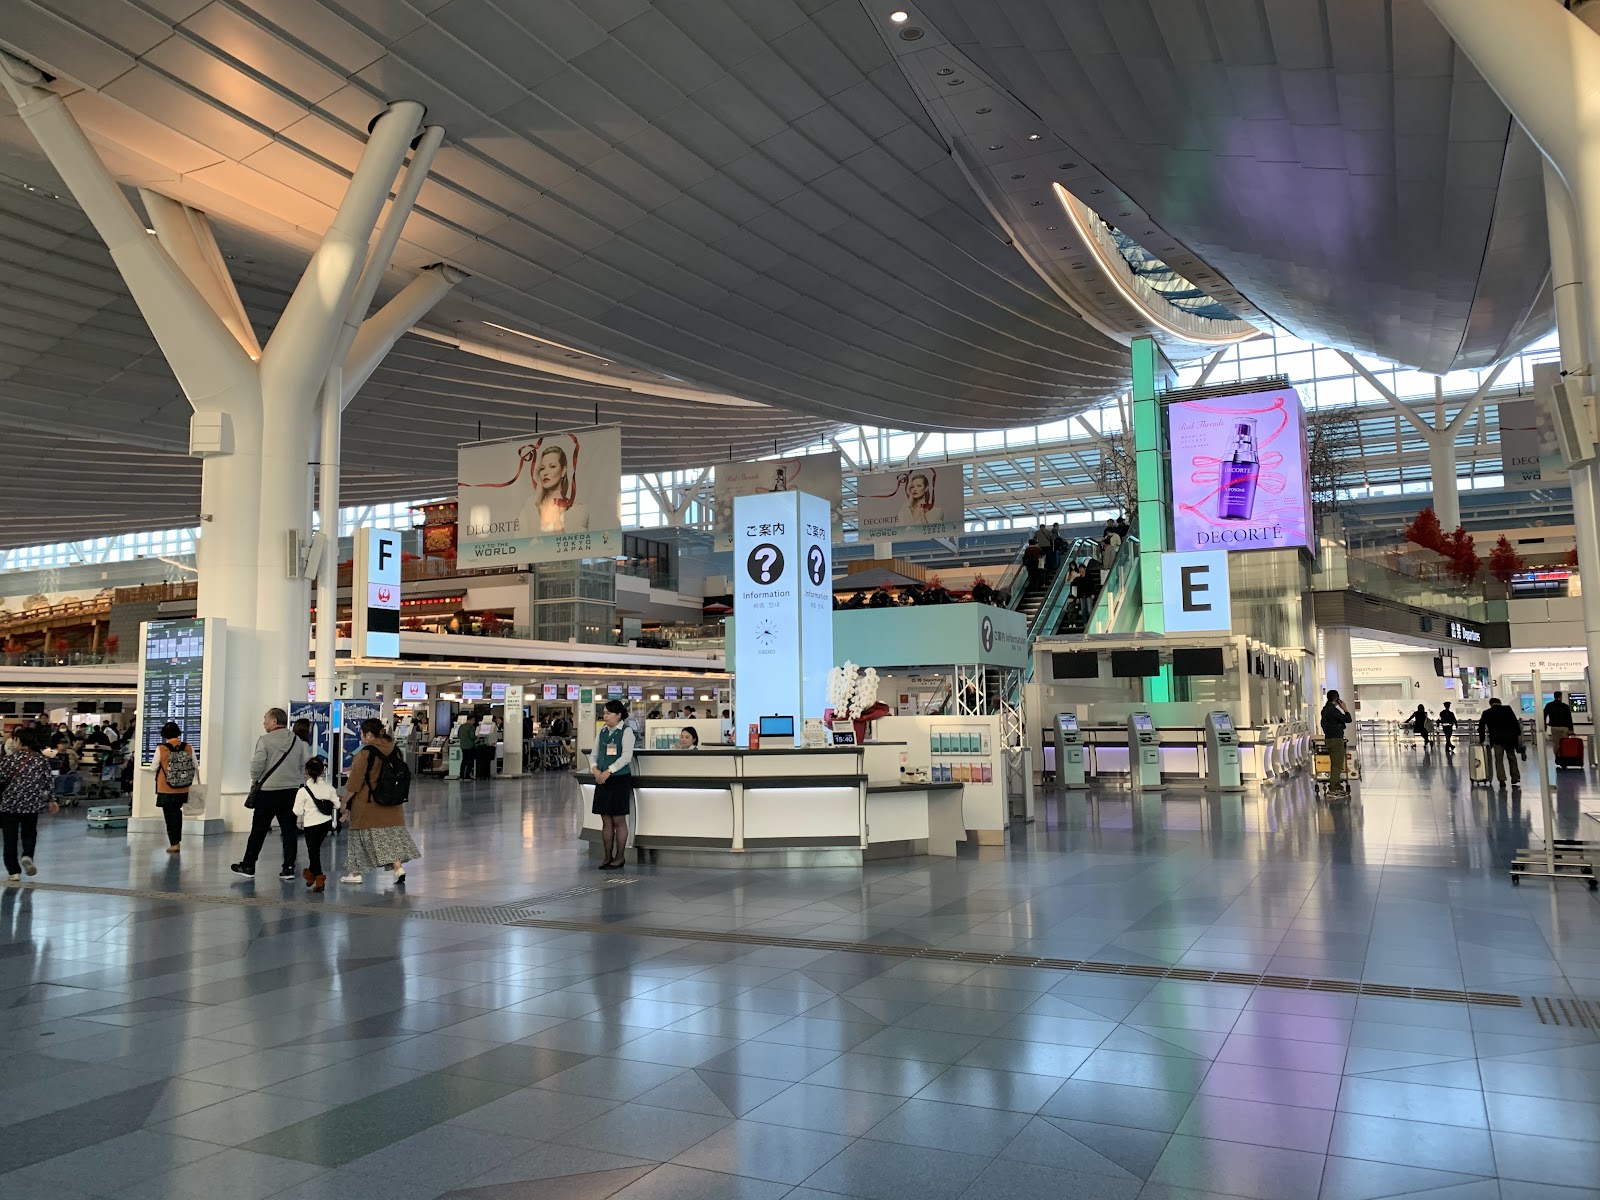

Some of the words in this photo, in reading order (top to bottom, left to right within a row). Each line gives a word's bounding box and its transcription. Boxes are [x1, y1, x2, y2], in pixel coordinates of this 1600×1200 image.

[1179, 422, 1194, 431] Red
[1196, 419, 1225, 429] Threads
[863, 515, 899, 526] DECORTÉ
[466, 518, 520, 536] DECORTÉ
[746, 522, 785, 537] ご案内
[806, 523, 826, 541] ご案内
[556, 534, 591, 542] HANEDA
[869, 530, 898, 538] WORLD
[1197, 523, 1283, 545] DECORTÉ
[556, 539, 592, 548] TOKYO
[556, 545, 592, 554] JAPAN
[379, 539, 393, 571] F
[474, 546, 517, 557] WORLD
[1181, 565, 1212, 612] E
[742, 590, 790, 600] Information
[805, 589, 829, 601] Information
[1462, 626, 1481, 643] Departures
[340, 682, 347, 696] F
[362, 682, 369, 696] F
[1414, 681, 1421, 689] 4
[1492, 679, 1497, 687] 3
